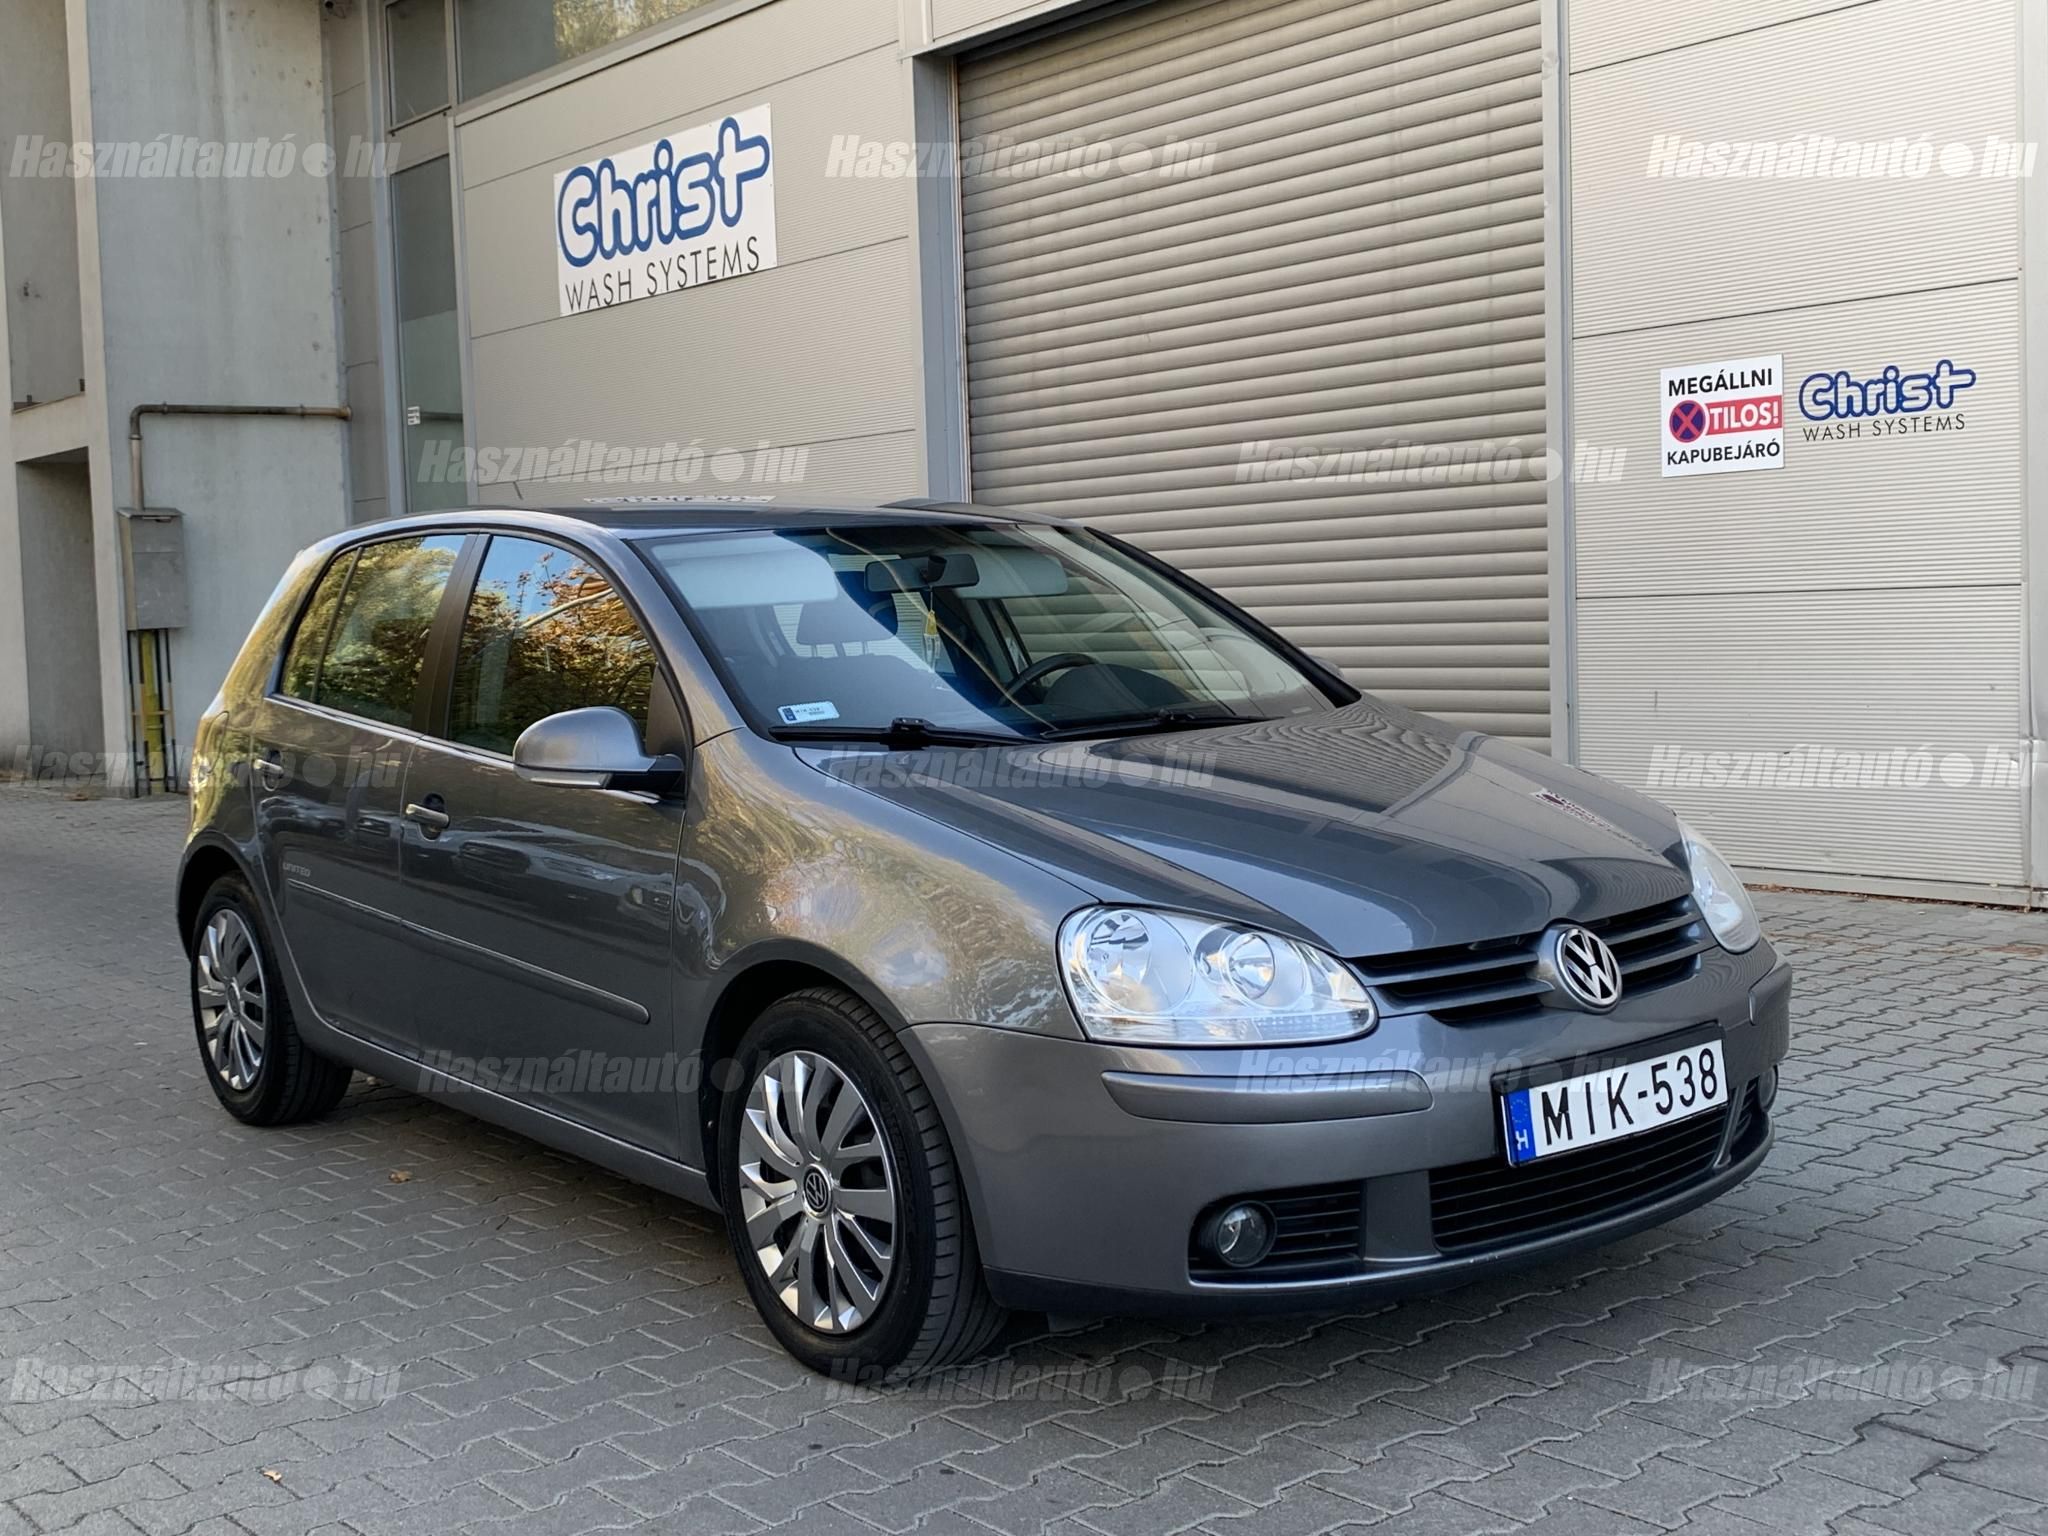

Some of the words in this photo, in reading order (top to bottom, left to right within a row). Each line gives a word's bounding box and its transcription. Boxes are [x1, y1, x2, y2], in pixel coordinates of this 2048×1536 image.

[558, 117, 769, 268] Christ
[565, 268, 632, 312] WASH
[646, 236, 760, 296] SYSTEMS
[1668, 368, 1773, 397] MEGÁLLNI
[1799, 359, 1976, 421] Christ
[1710, 403, 1779, 431] TILOS!
[1803, 423, 1861, 442] WASH
[1872, 413, 1966, 437] SYSTEMS
[1667, 440, 1780, 466] KAPUBEJÁRÓ
[1541, 1048, 1718, 1146] MIK-538
